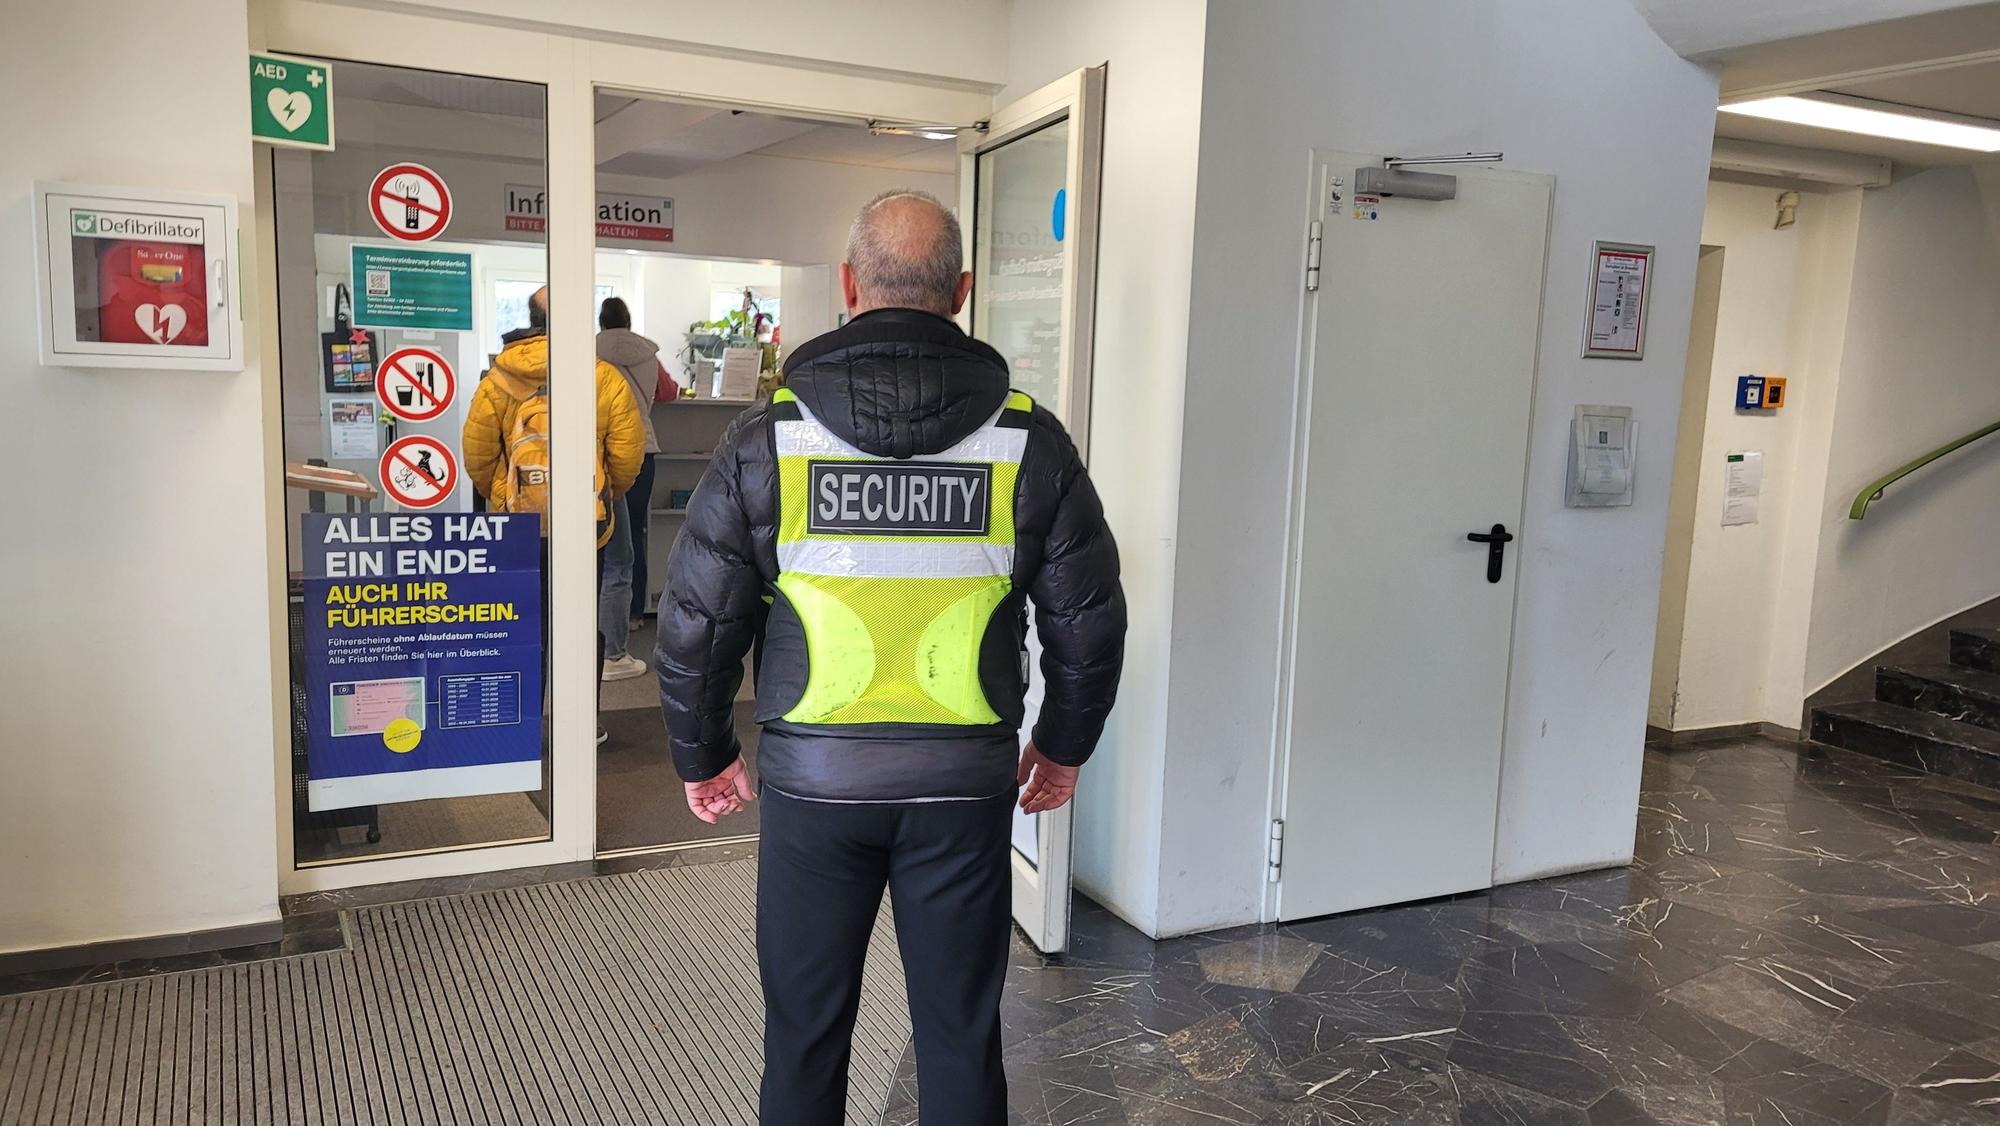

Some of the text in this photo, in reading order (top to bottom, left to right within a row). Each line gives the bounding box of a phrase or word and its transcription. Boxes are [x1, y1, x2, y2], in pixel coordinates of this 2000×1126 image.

[255, 62, 287, 80] AED
[509, 191, 661, 224] Infation
[100, 217, 201, 239] Defibrillator
[509, 218, 541, 230] BITTE
[818, 473, 980, 523] SECURITY
[323, 516, 510, 544] ALLES HAT
[325, 548, 497, 577] EIN ENDE.
[326, 582, 449, 605] AUCH IHR
[326, 602, 520, 629] FÜHRERSCHEIN.
[328, 631, 508, 646] Führerscheine ohne Ablaufdatum müssen
[328, 645, 404, 656] erneuert werden.
[328, 647, 501, 665] Alle Fristen finden Sie hier im Überblick.
